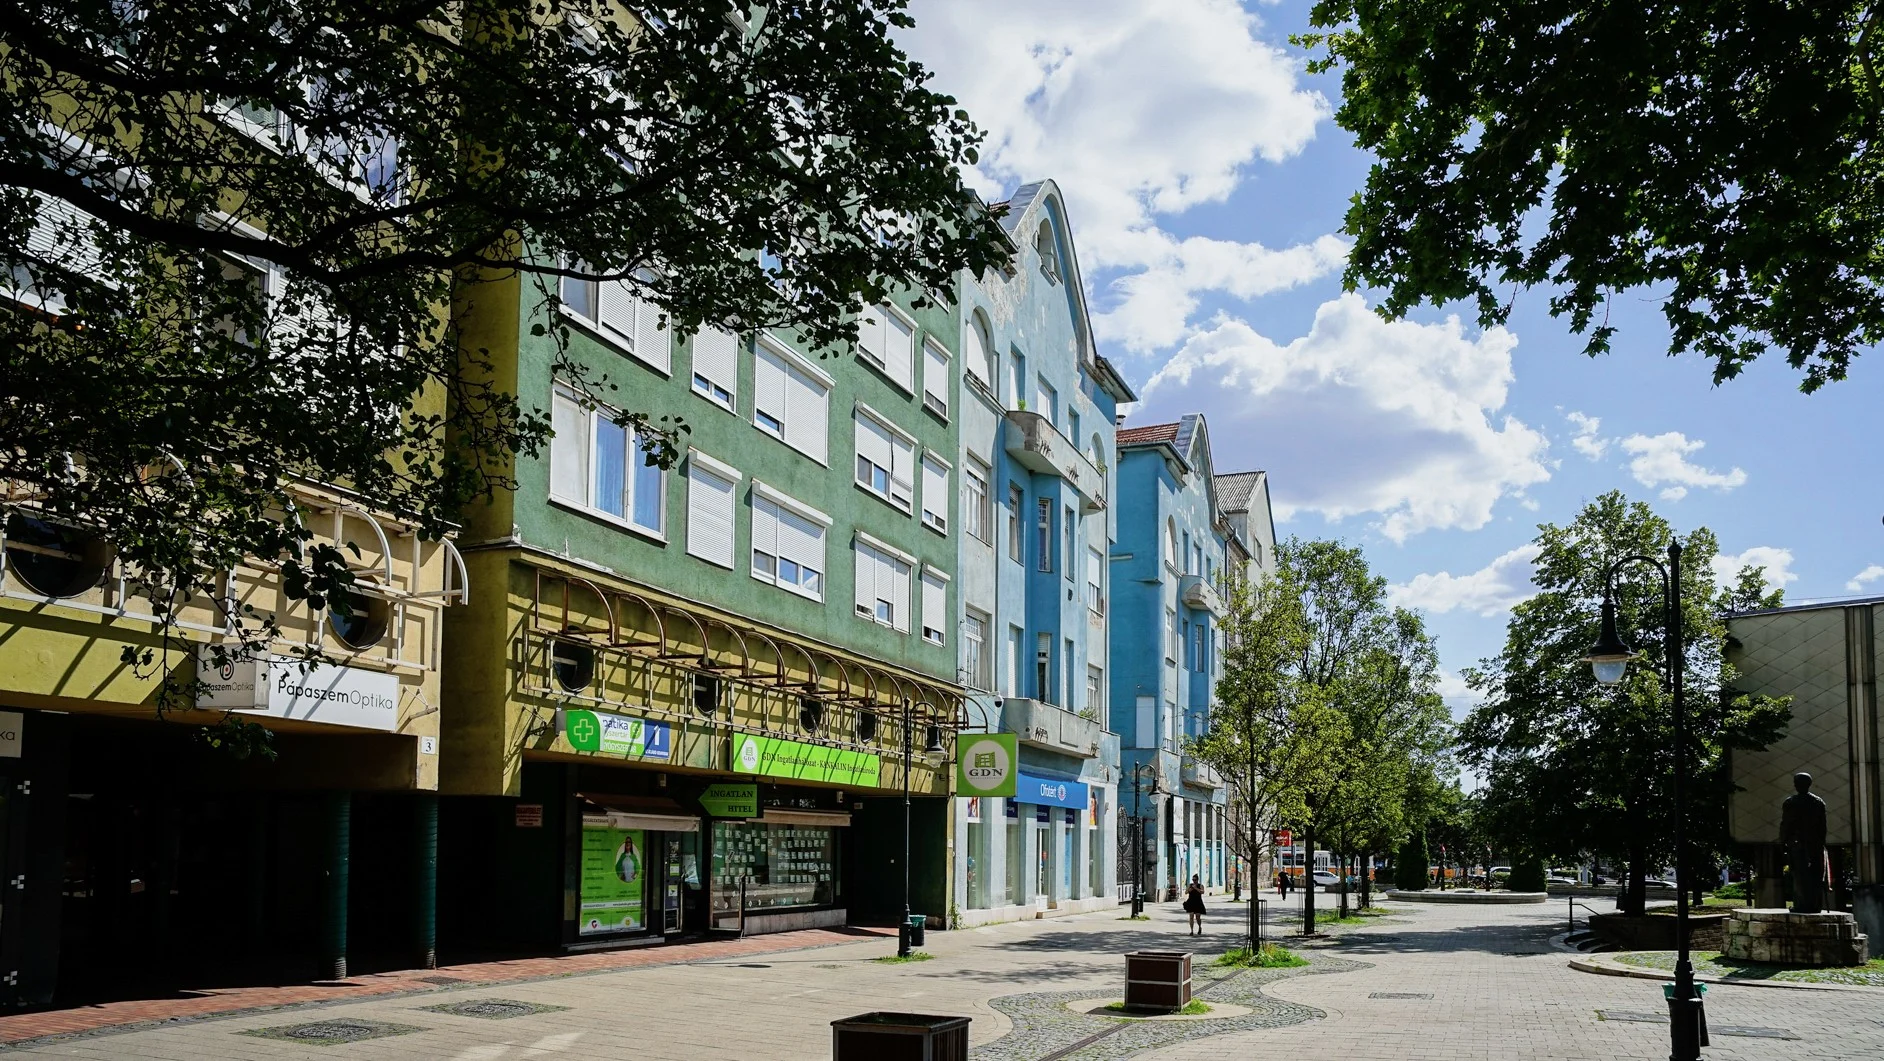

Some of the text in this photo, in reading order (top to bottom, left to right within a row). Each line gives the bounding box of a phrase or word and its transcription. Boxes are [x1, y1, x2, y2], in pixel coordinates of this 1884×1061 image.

[198, 681, 254, 693] paszemOptika
[425, 741, 432, 752] 3
[968, 768, 1004, 777] GDN
[710, 790, 753, 798] INGATLAN
[727, 805, 753, 813] HITEL
